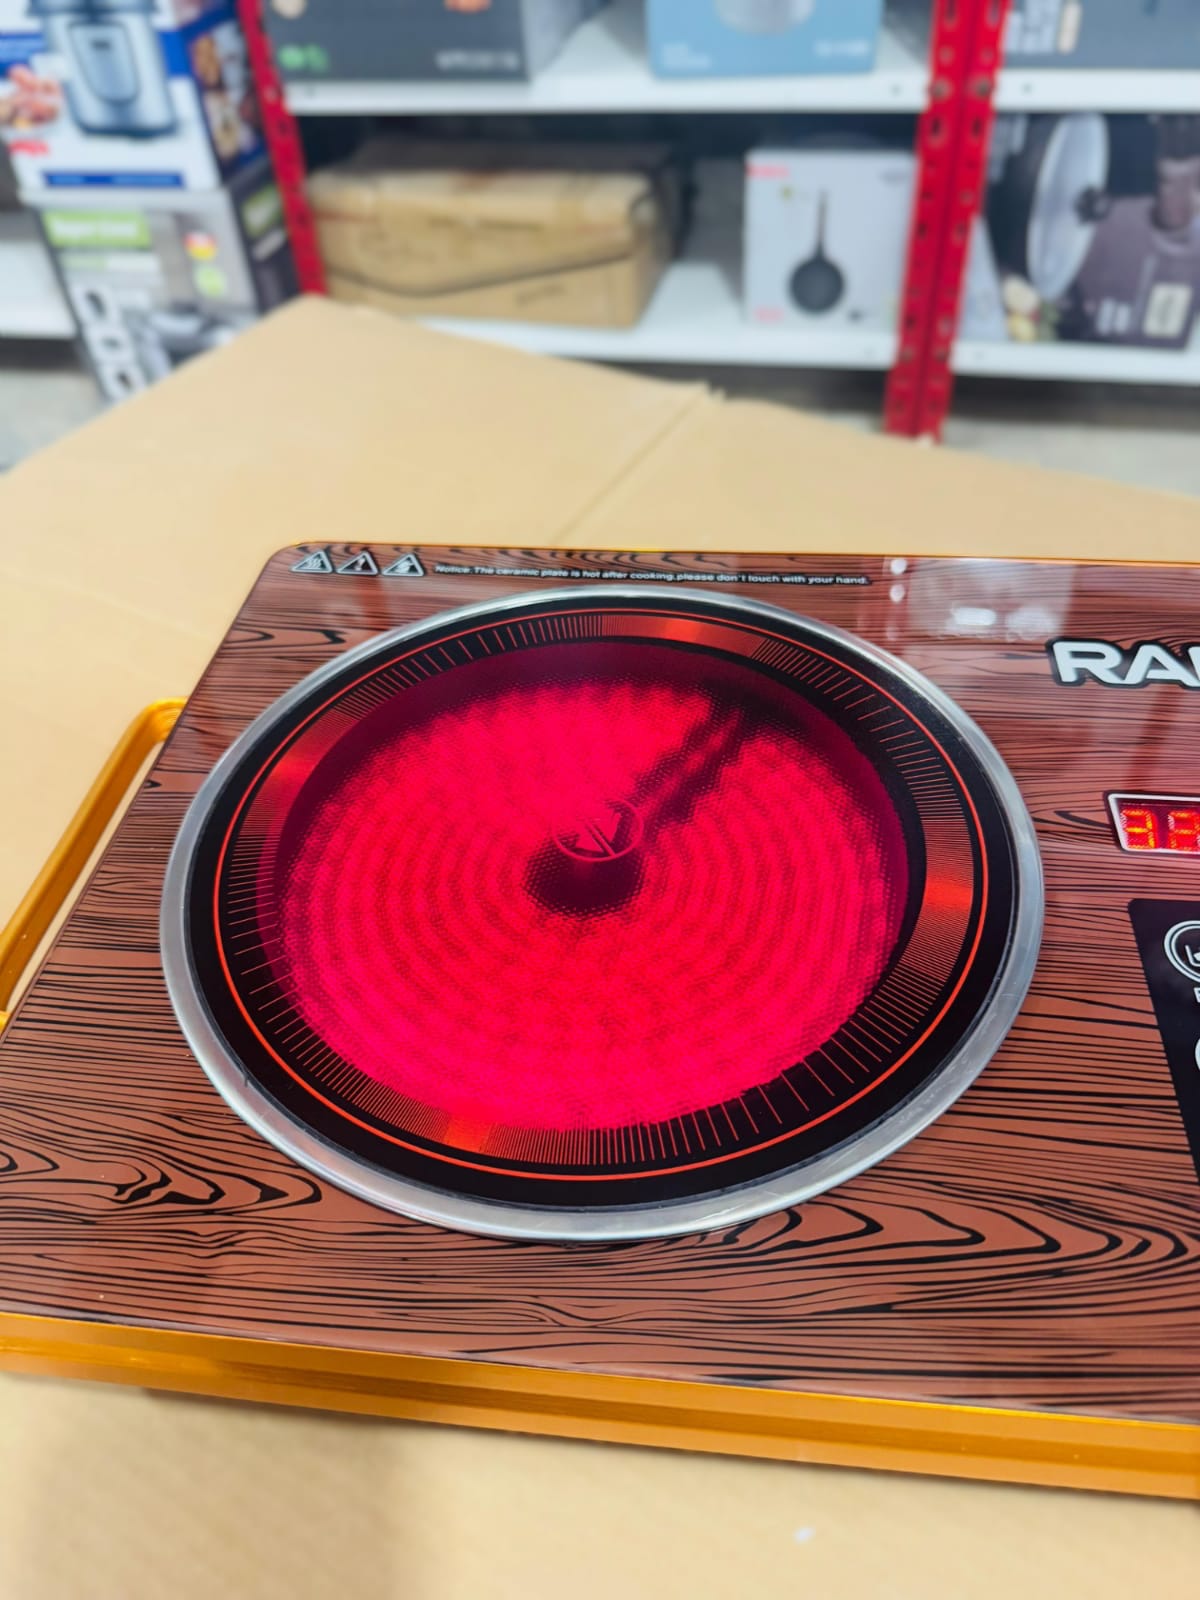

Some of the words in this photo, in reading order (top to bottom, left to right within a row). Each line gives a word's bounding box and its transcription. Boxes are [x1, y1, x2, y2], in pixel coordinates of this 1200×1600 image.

[496, 568, 539, 576] ceramic
[541, 568, 569, 578] plate
[582, 570, 601, 578] hot
[716, 574, 745, 582] don't
[747, 575, 780, 583] touch
[807, 577, 834, 585] your
